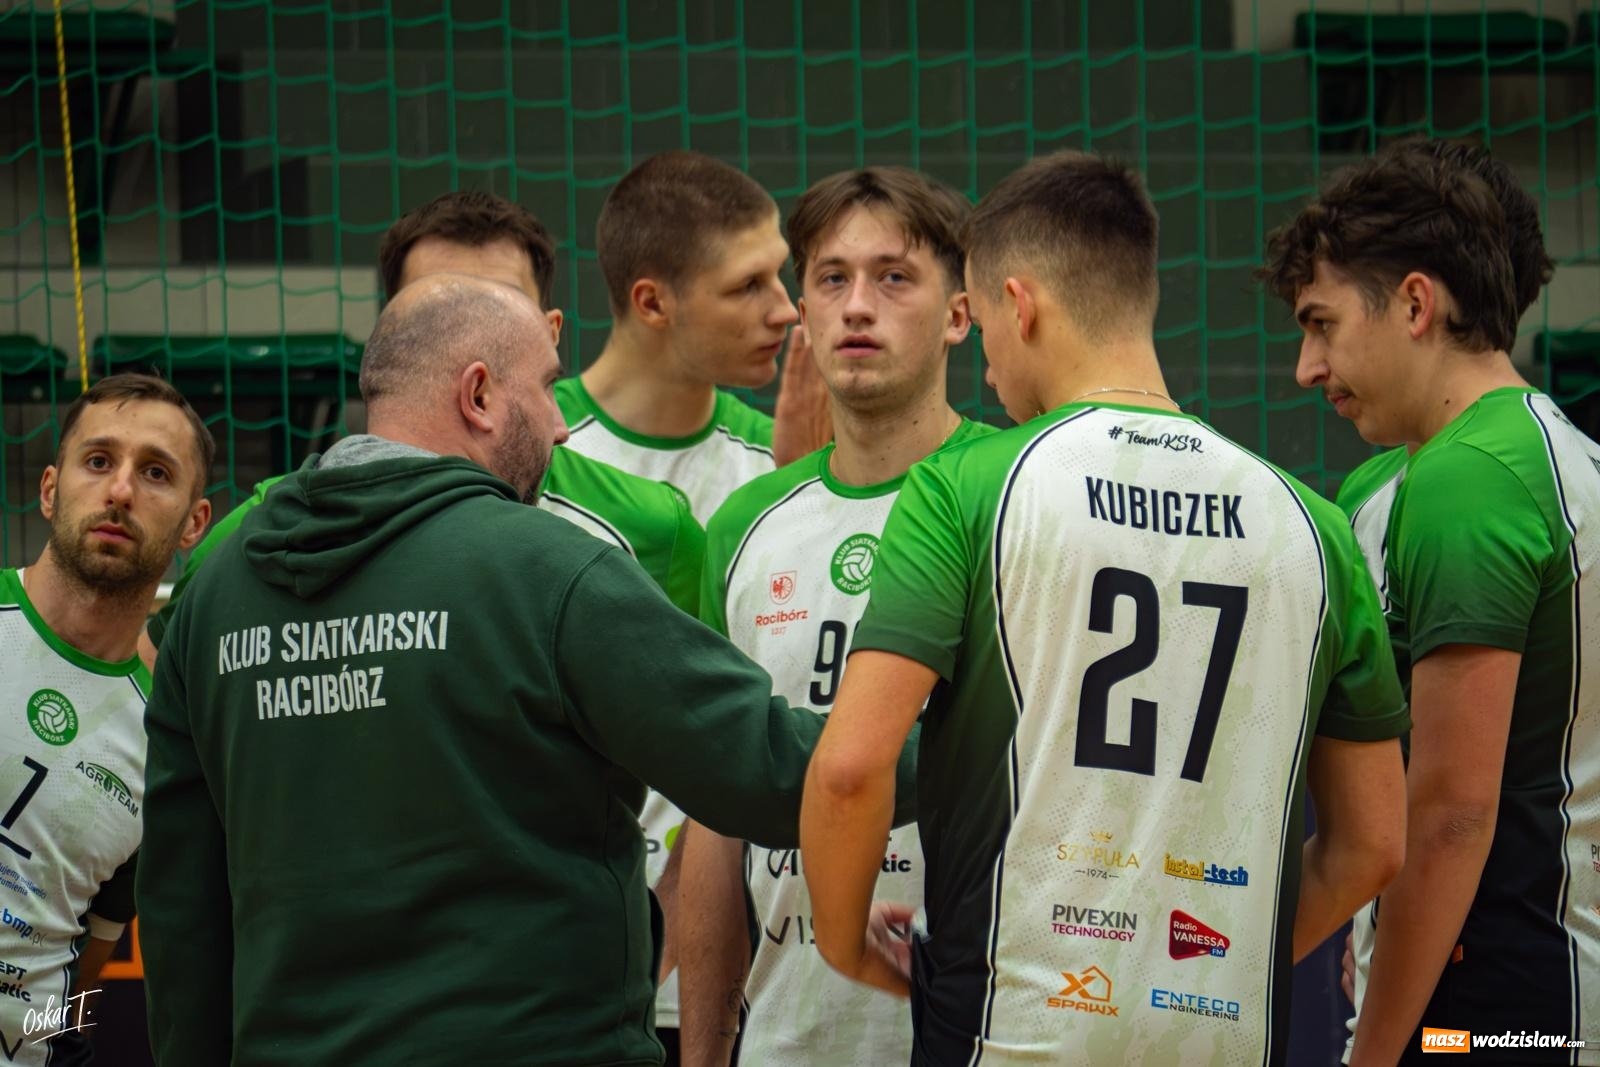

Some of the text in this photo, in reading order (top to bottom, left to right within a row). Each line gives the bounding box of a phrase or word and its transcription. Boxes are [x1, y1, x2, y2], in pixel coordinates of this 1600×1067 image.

[1085, 475, 1246, 539] KUBICZEK
[755, 608, 808, 627] Racibórz
[218, 611, 448, 675] KLUB SIATKARSKI
[809, 620, 861, 706] 9
[1074, 566, 1249, 784] 27
[256, 663, 387, 720] RACIBÓRZ
[1087, 868, 1108, 880] 1974
[1052, 903, 1138, 931] PIVEXIN
[1173, 921, 1198, 932] Radio
[1051, 922, 1136, 943] TECHNOLOGY
[1173, 930, 1226, 949] VANESSA
[1211, 948, 1225, 957] FM
[1047, 997, 1120, 1018] SPAWX
[1151, 988, 1240, 1014] ENTECO
